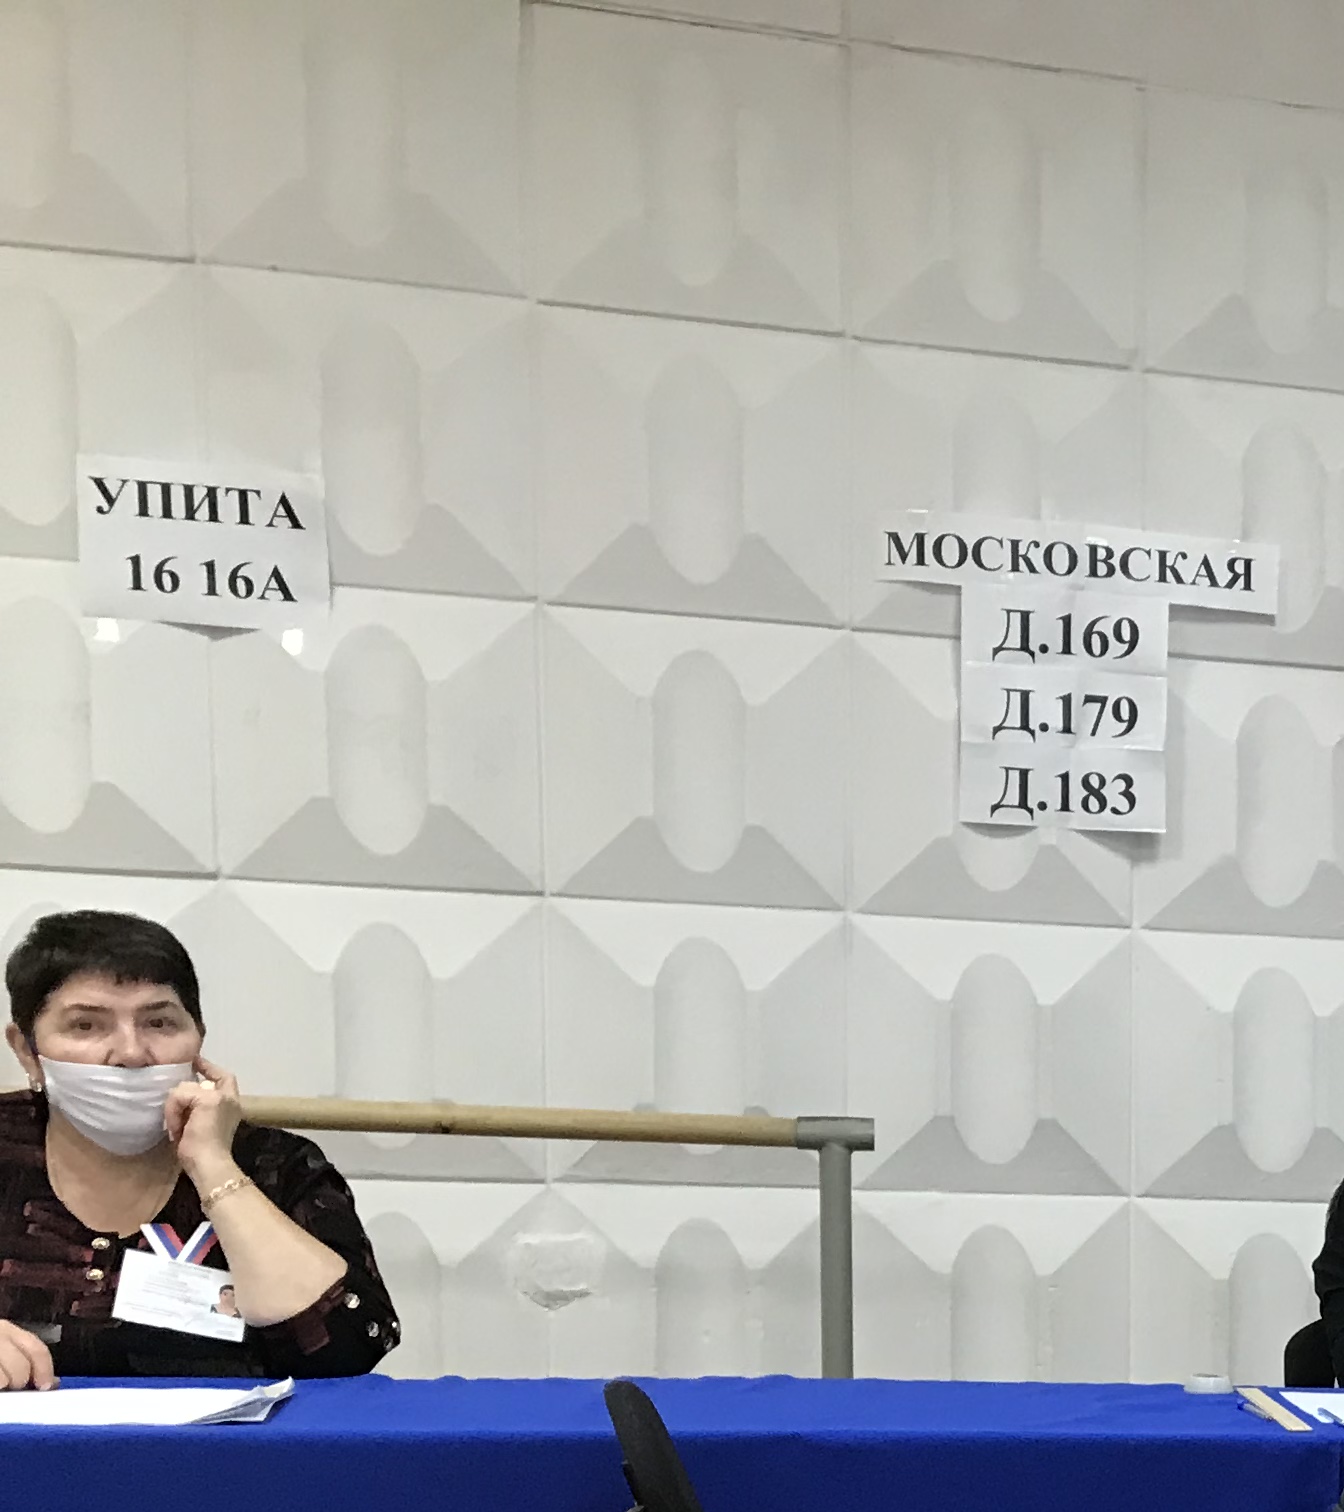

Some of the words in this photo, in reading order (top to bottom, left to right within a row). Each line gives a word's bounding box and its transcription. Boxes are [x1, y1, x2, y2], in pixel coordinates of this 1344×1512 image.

[88, 475, 306, 529] УПИТА
[126, 553, 180, 593] 16
[199, 558, 298, 603] 16А
[884, 530, 1256, 592] МОСКОВСКАЯ
[991, 608, 1140, 664] Д.169
[991, 688, 1139, 743] Д.179
[990, 766, 1137, 821] Д.183
